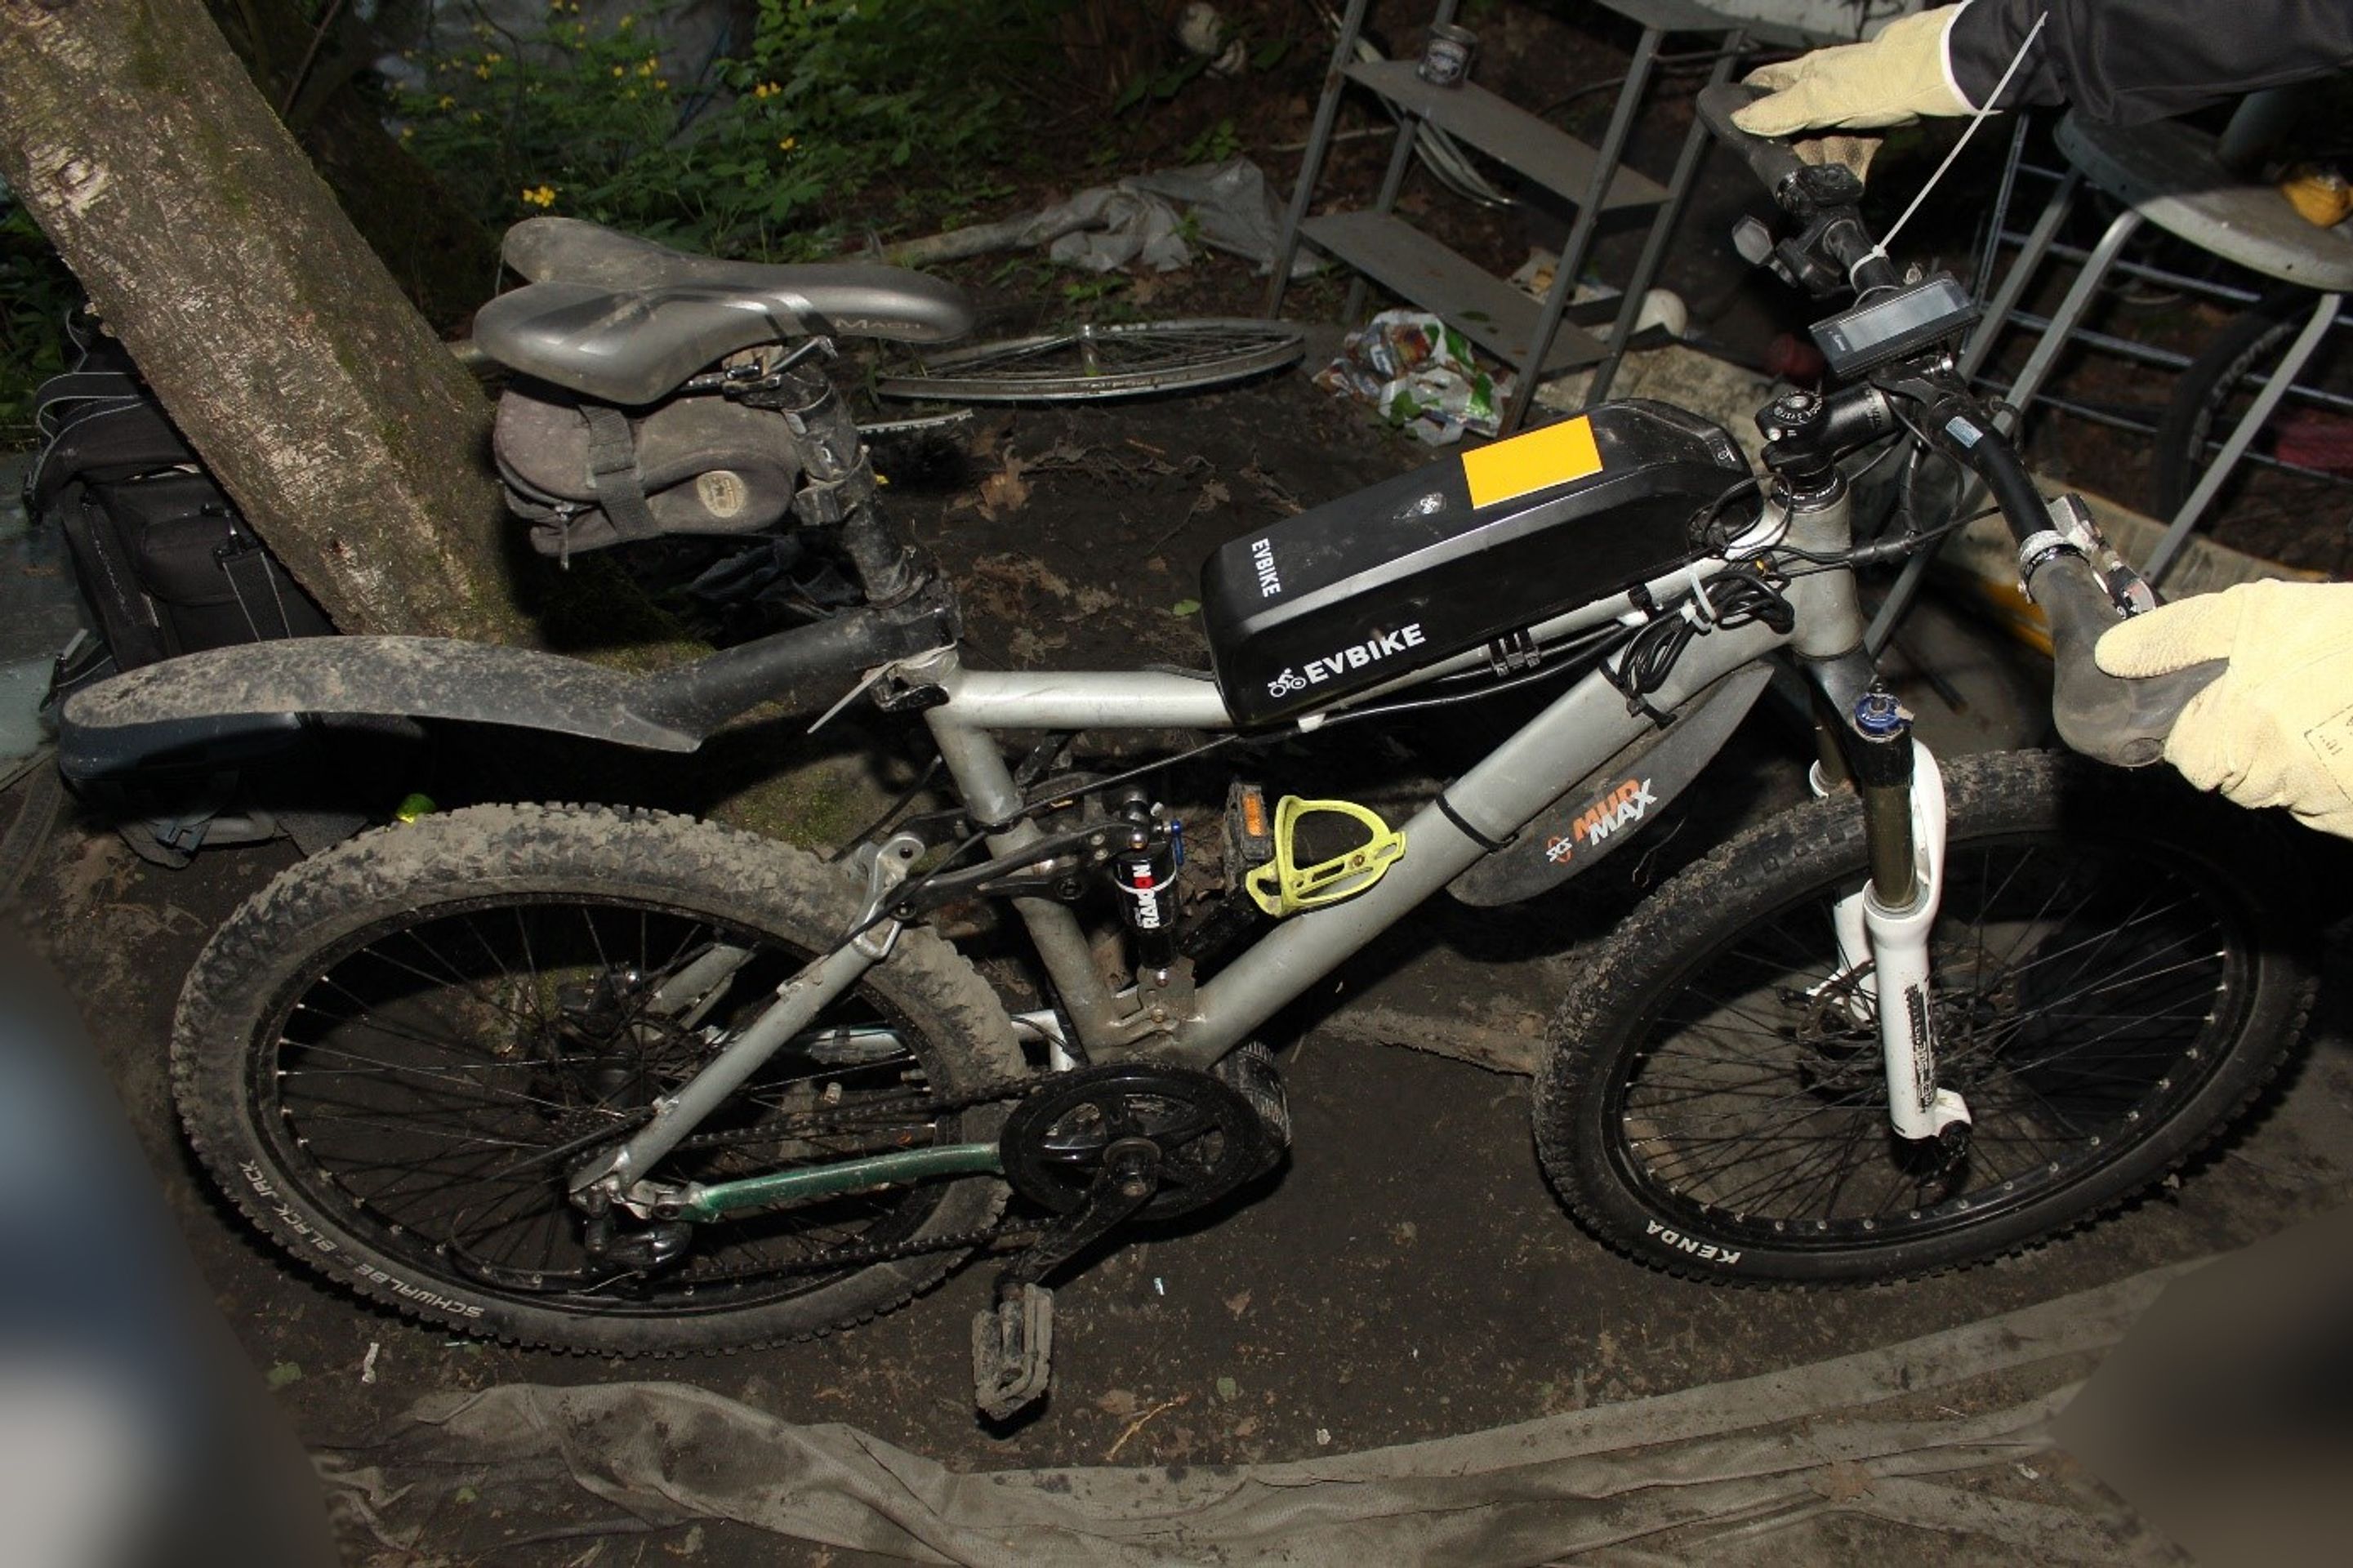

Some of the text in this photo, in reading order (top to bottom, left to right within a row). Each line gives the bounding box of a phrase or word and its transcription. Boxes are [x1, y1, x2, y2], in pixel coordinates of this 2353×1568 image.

[1251, 537, 1281, 597] EVBIKE
[1304, 623, 1426, 684] EVBIKE
[1573, 777, 1640, 842] MUD
[1589, 777, 1658, 846] MAX
[238, 1160, 485, 1317] SCHWALBE BLACK JACK
[1646, 1219, 1741, 1264] KENDA
